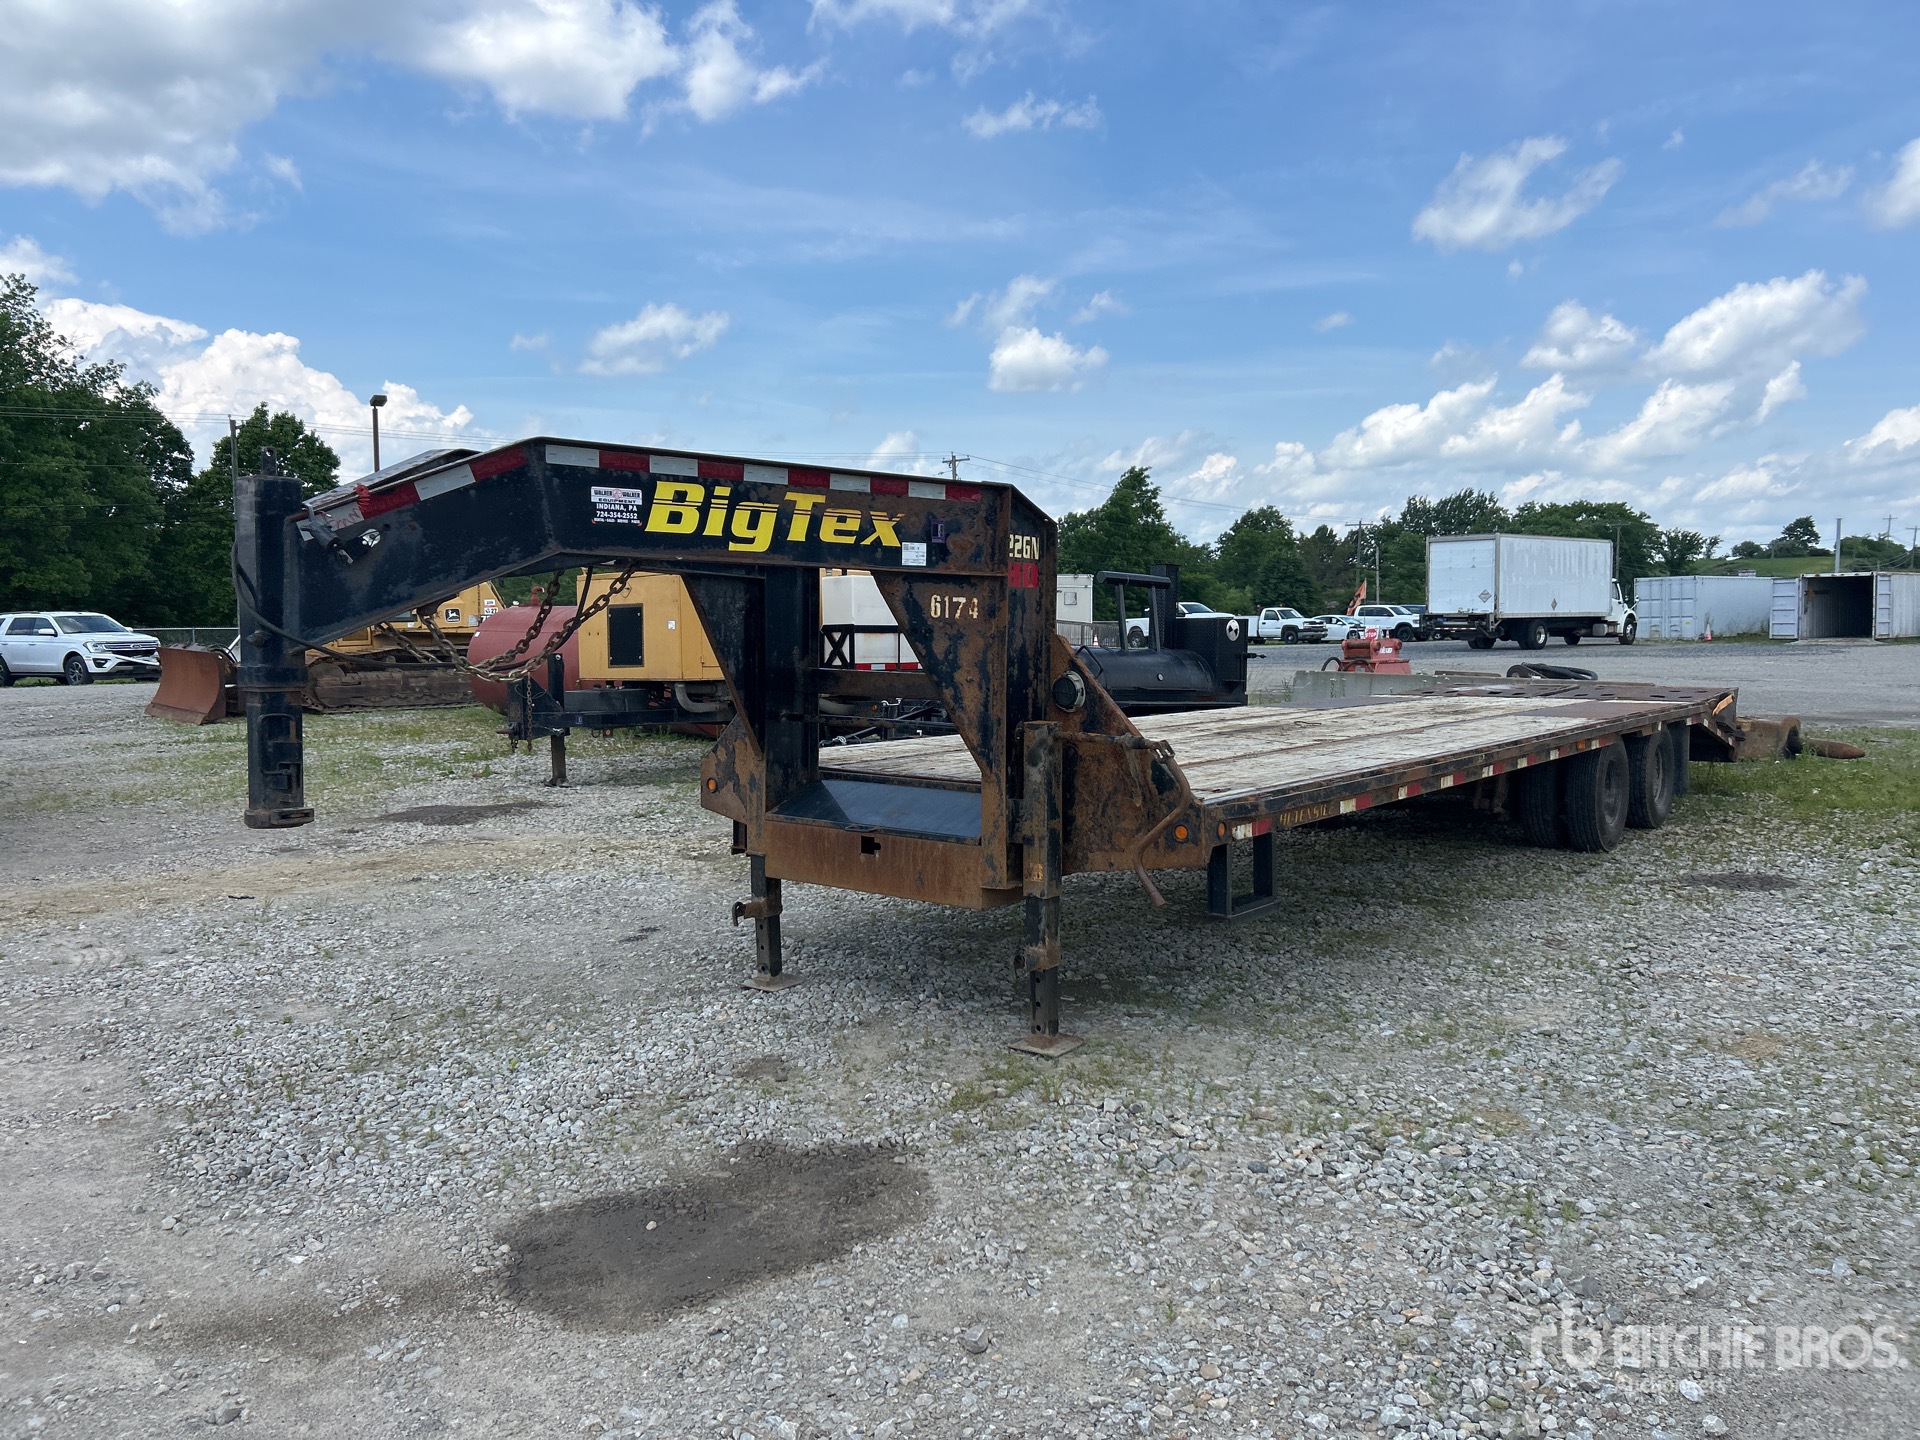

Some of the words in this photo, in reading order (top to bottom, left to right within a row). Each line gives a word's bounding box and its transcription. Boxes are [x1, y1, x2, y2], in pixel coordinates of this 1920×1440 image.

[596, 503, 627, 511] INDIANA,
[596, 511, 638, 519] 724-354-2552
[644, 481, 905, 552] BigTex
[930, 594, 978, 619] 6174
